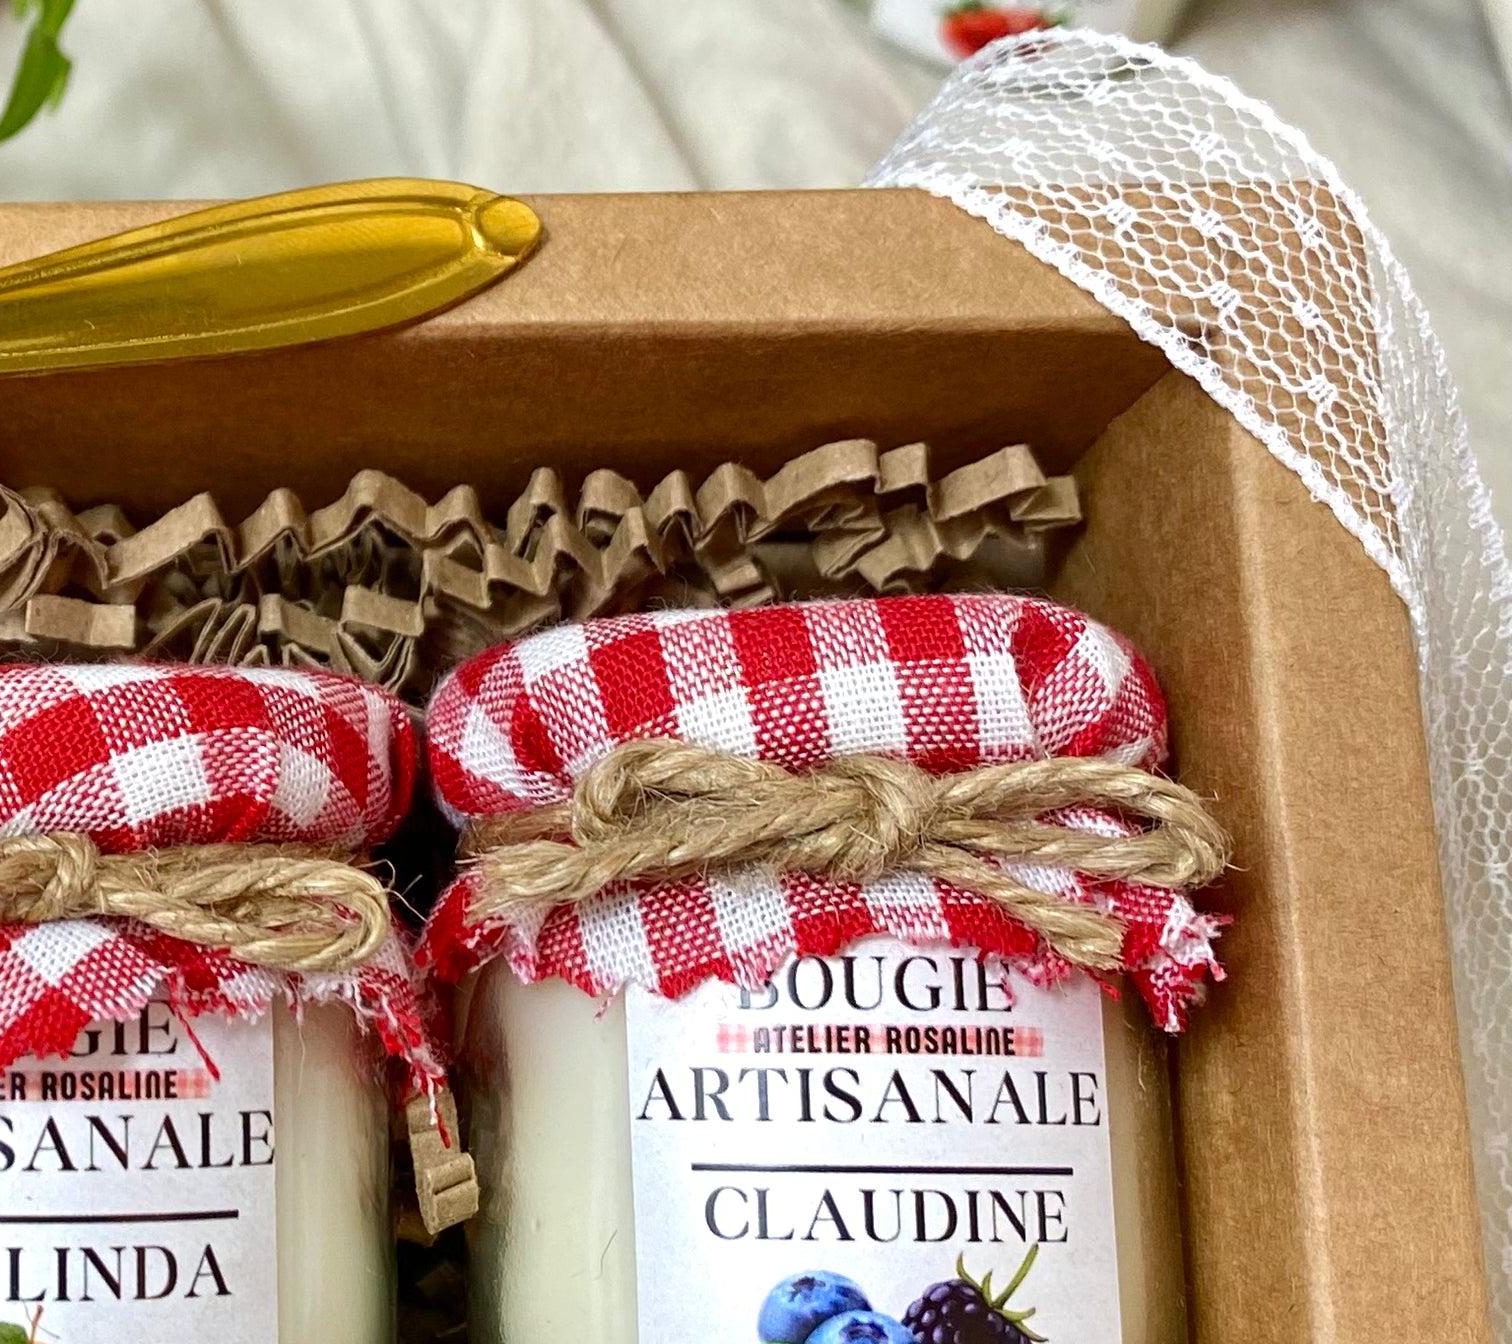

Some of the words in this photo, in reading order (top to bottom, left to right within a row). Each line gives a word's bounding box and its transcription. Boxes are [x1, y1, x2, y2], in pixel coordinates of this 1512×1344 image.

[752, 1024, 872, 1055] ATELIER
[886, 1025, 1017, 1057] ROSALINE
[41, 1069, 179, 1101] ROSALINE
[635, 1065, 1103, 1128] ARTISANALE
[702, 1184, 1071, 1245] CLAUDINE
